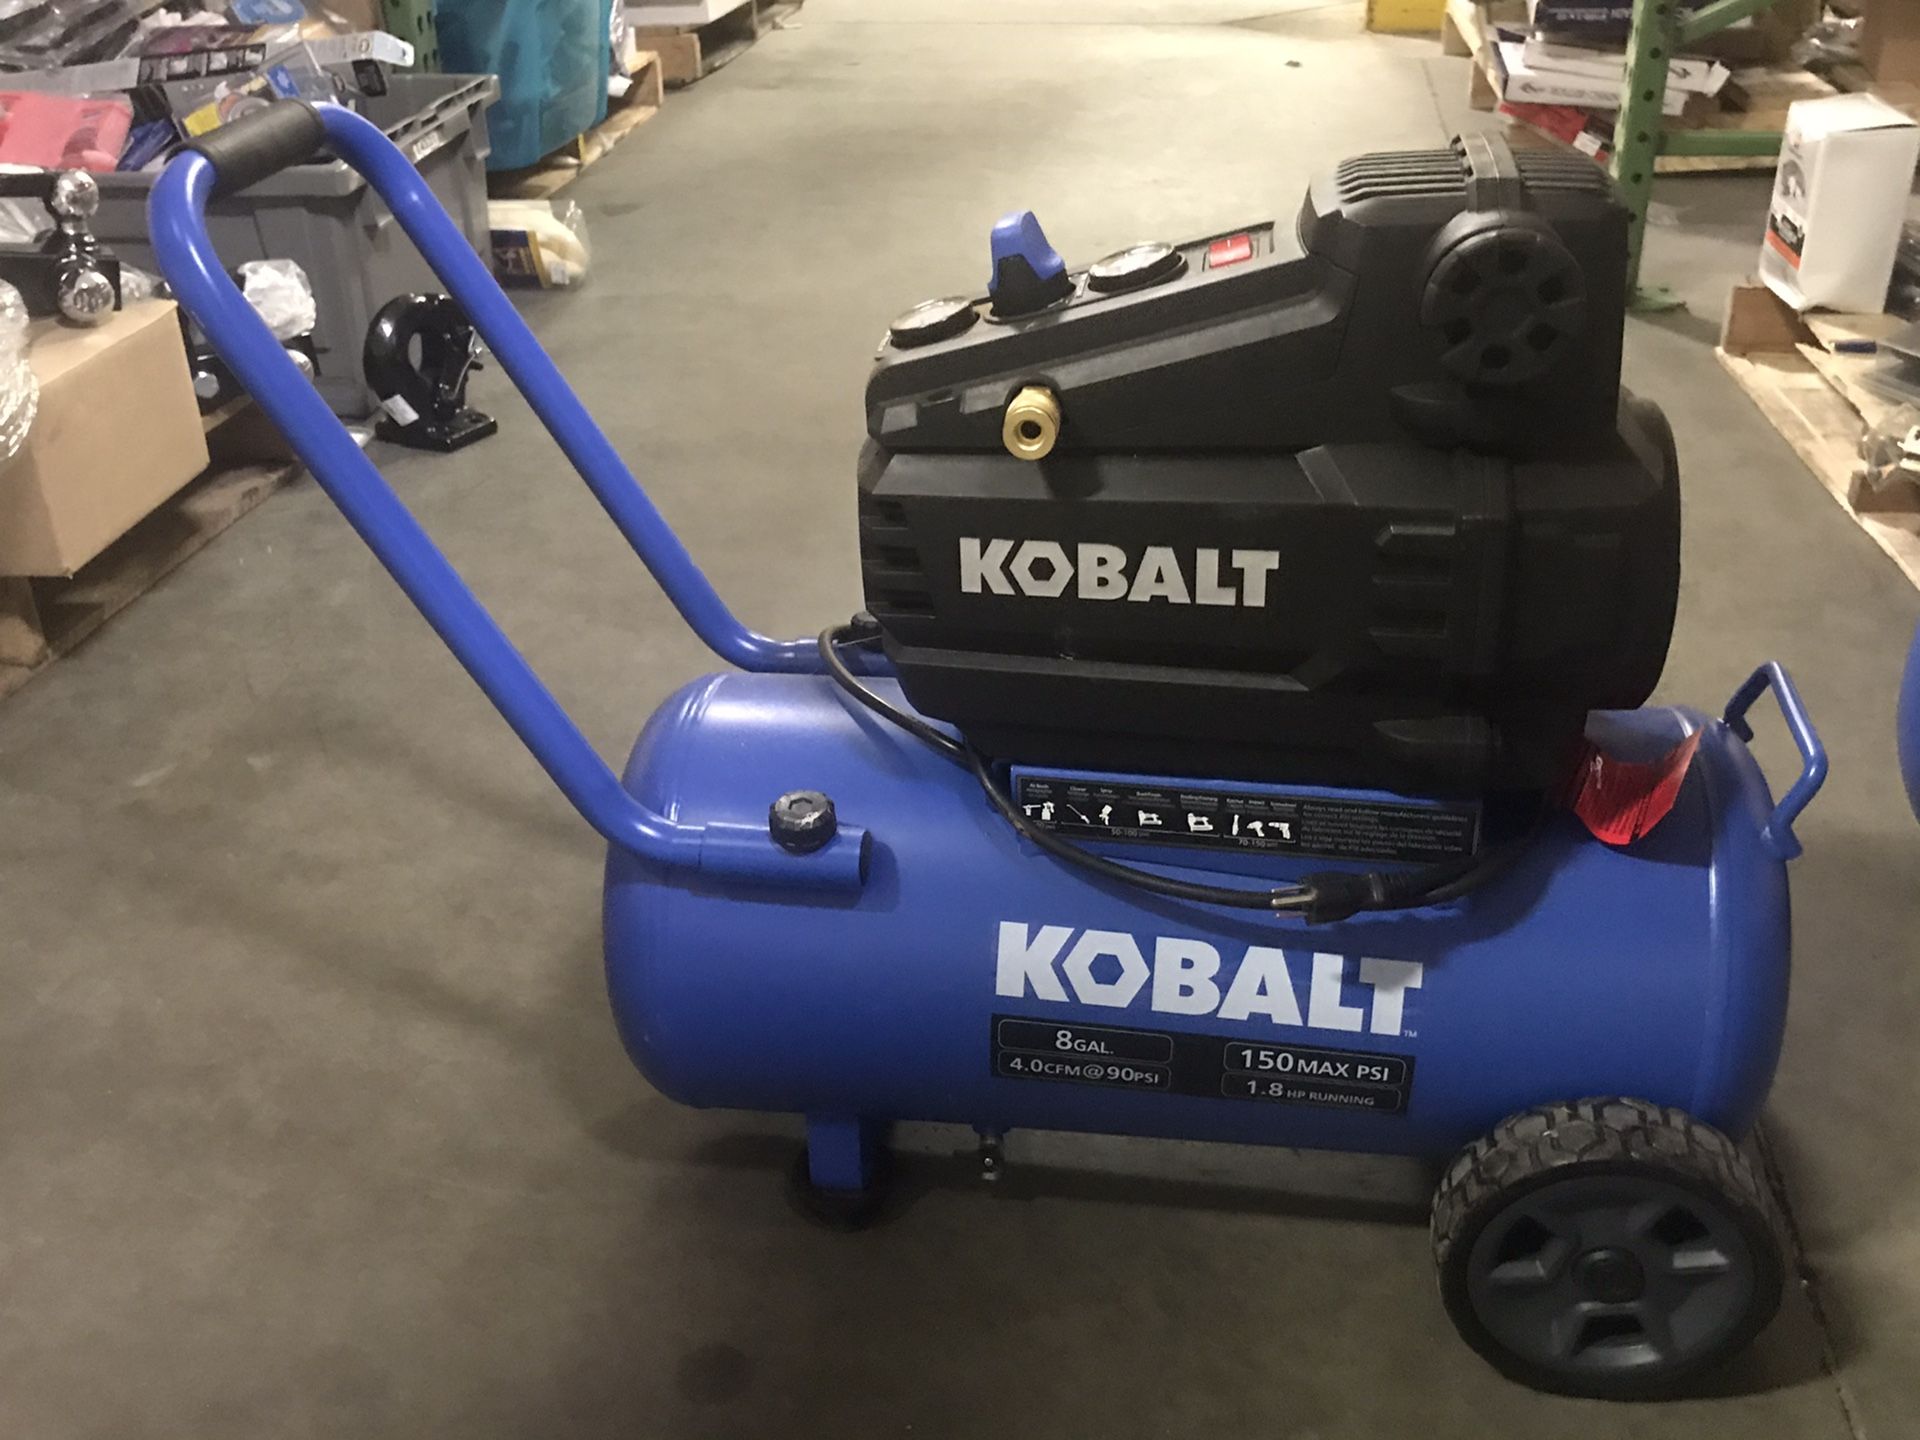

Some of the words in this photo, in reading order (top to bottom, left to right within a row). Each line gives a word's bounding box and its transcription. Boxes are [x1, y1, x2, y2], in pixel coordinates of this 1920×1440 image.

[958, 537, 1280, 608] KOBALT
[995, 920, 1424, 1036] KOBALT
[1356, 1064, 1390, 1082] PSI
[1308, 1089, 1375, 1106] RUNNING
